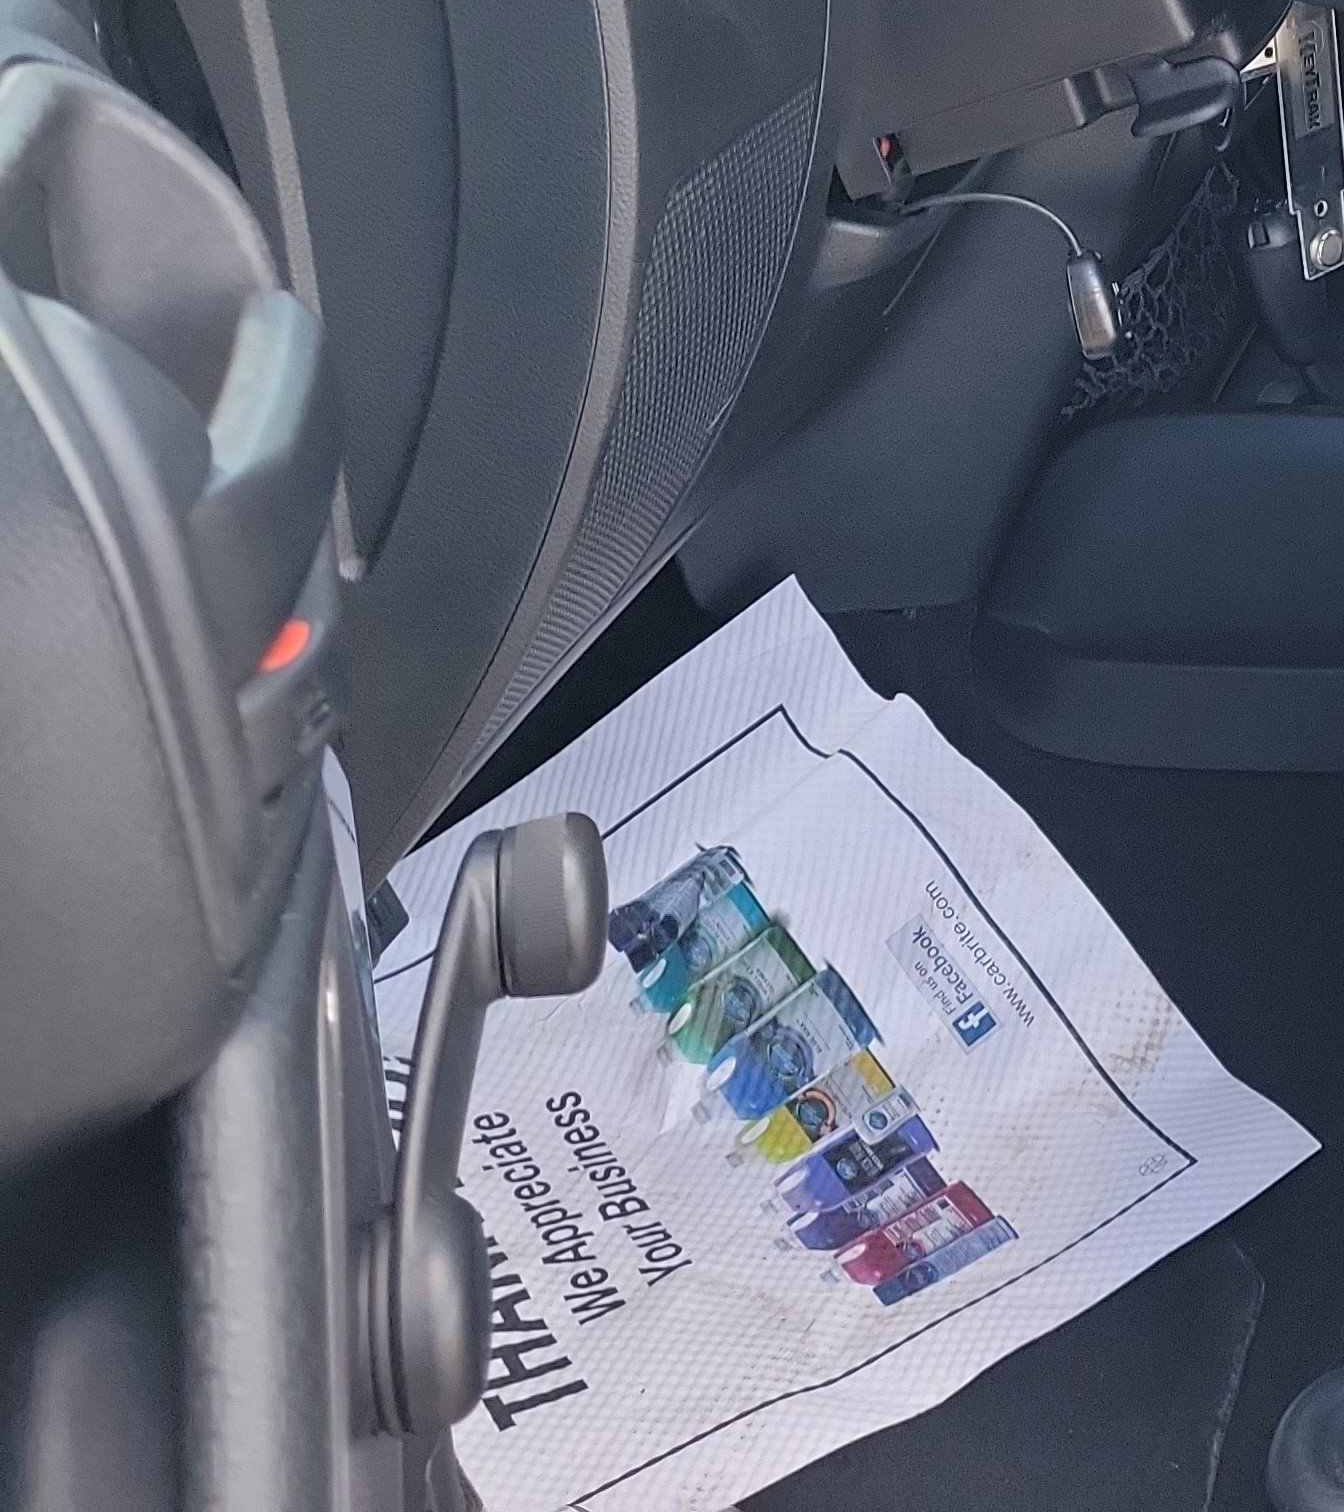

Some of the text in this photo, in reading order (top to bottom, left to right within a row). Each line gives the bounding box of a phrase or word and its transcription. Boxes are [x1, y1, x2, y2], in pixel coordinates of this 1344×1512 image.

[912, 925, 974, 1005] Facebook
[914, 961, 957, 1016] Find us on
[925, 880, 1035, 1028] www.carbrite.com
[471, 1111, 627, 1326] We Appreciate
[545, 1090, 693, 1288] Your Business
[481, 1232, 590, 1432] THA
